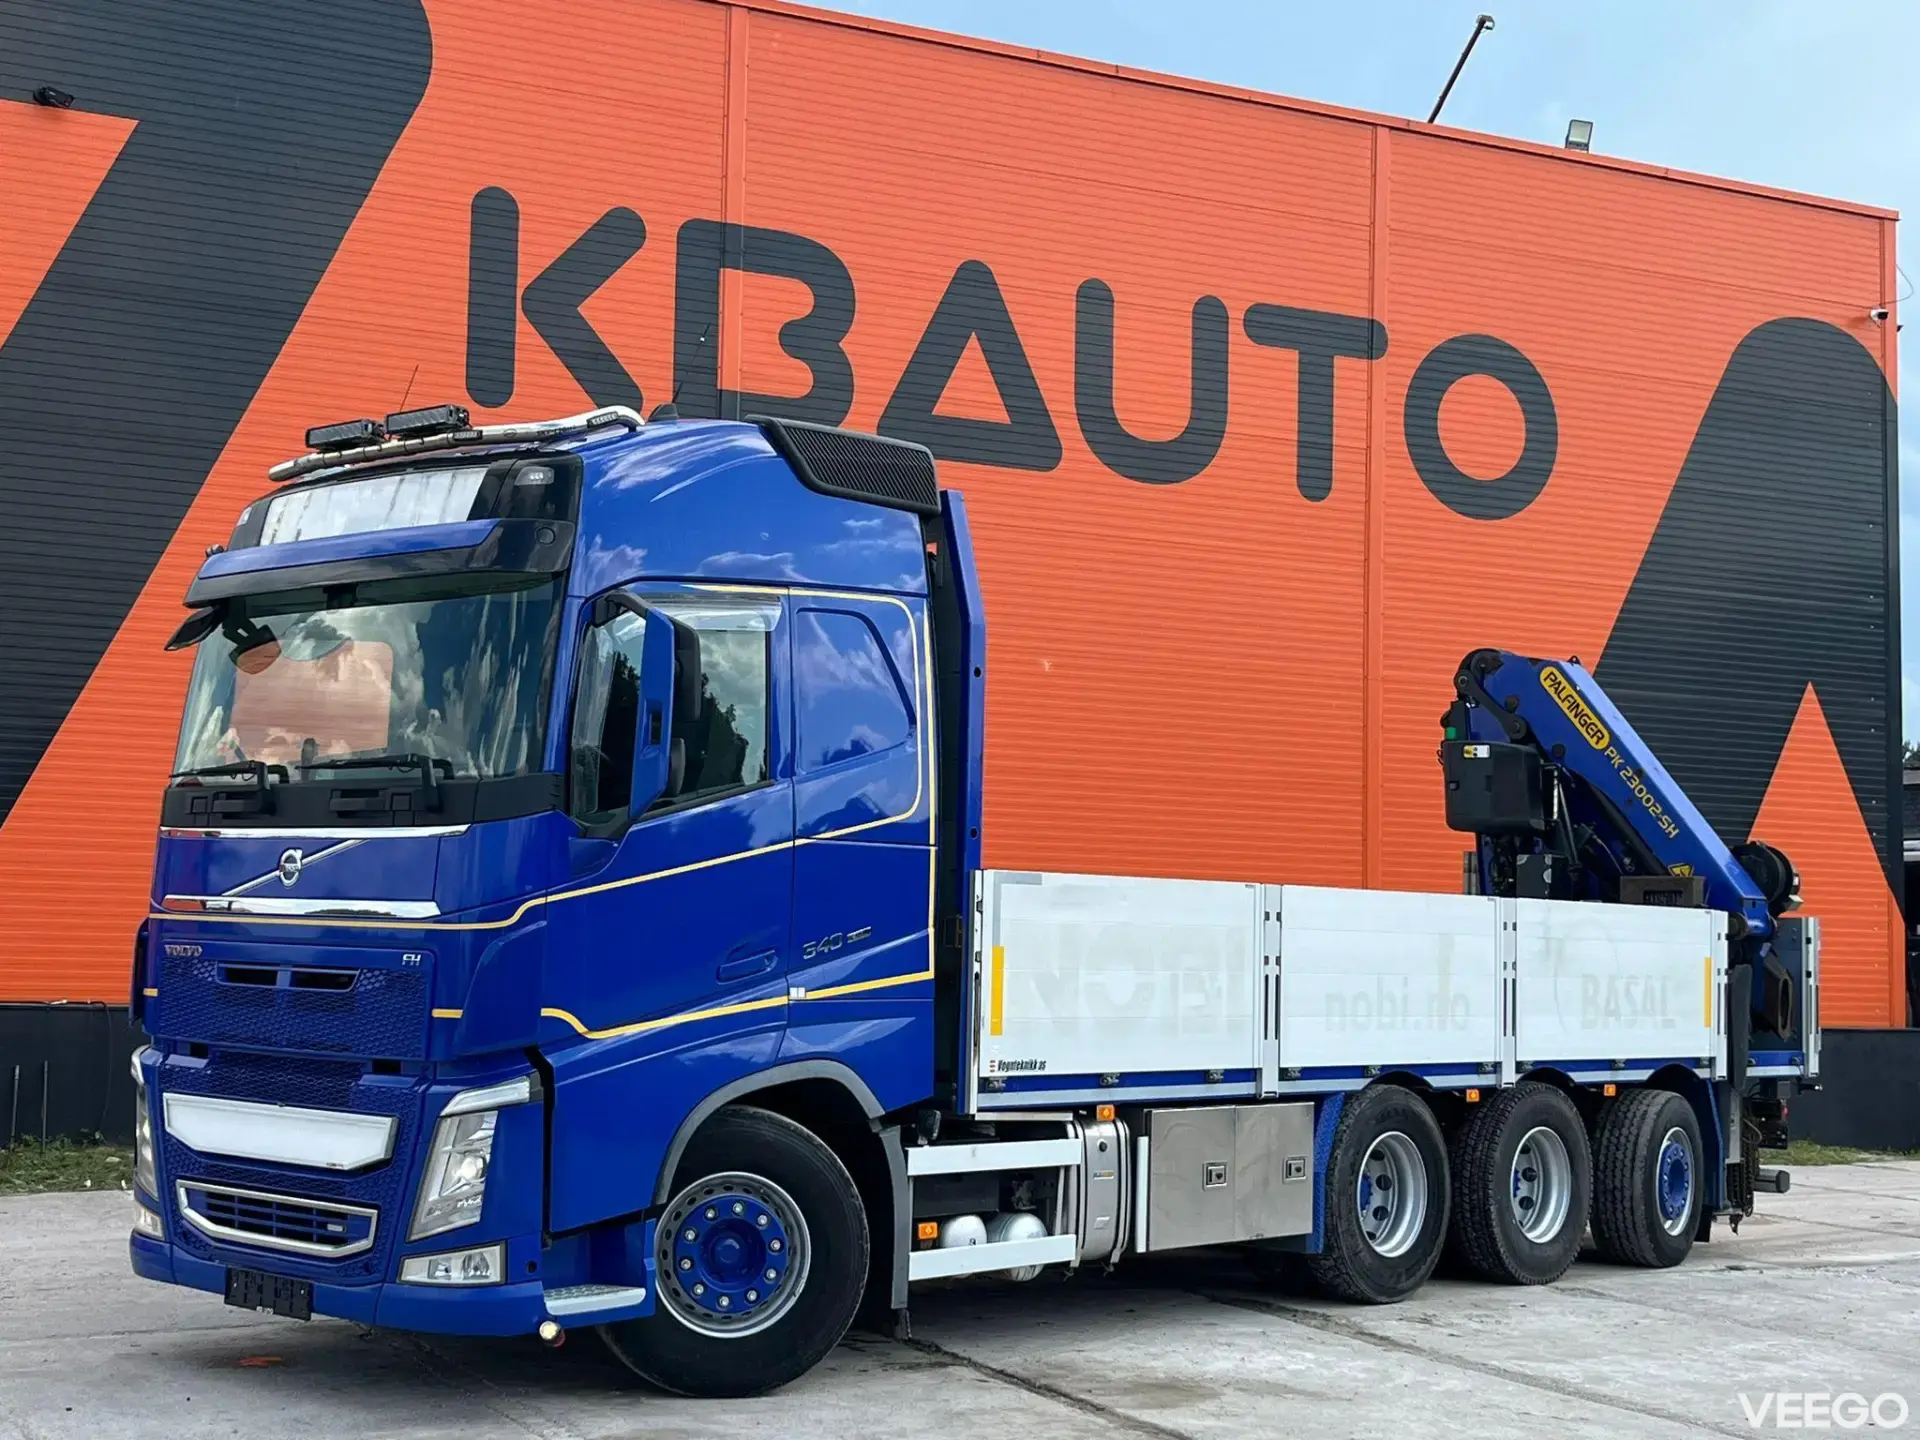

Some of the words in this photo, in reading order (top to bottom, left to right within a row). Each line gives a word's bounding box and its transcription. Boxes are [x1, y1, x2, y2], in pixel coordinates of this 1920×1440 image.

[465, 185, 1559, 521] KBAUTO
[1543, 671, 1605, 745] PALFINGER
[1604, 746, 1625, 769] PK
[1620, 766, 1680, 839] 23002-SH
[164, 944, 203, 957] VOLVO
